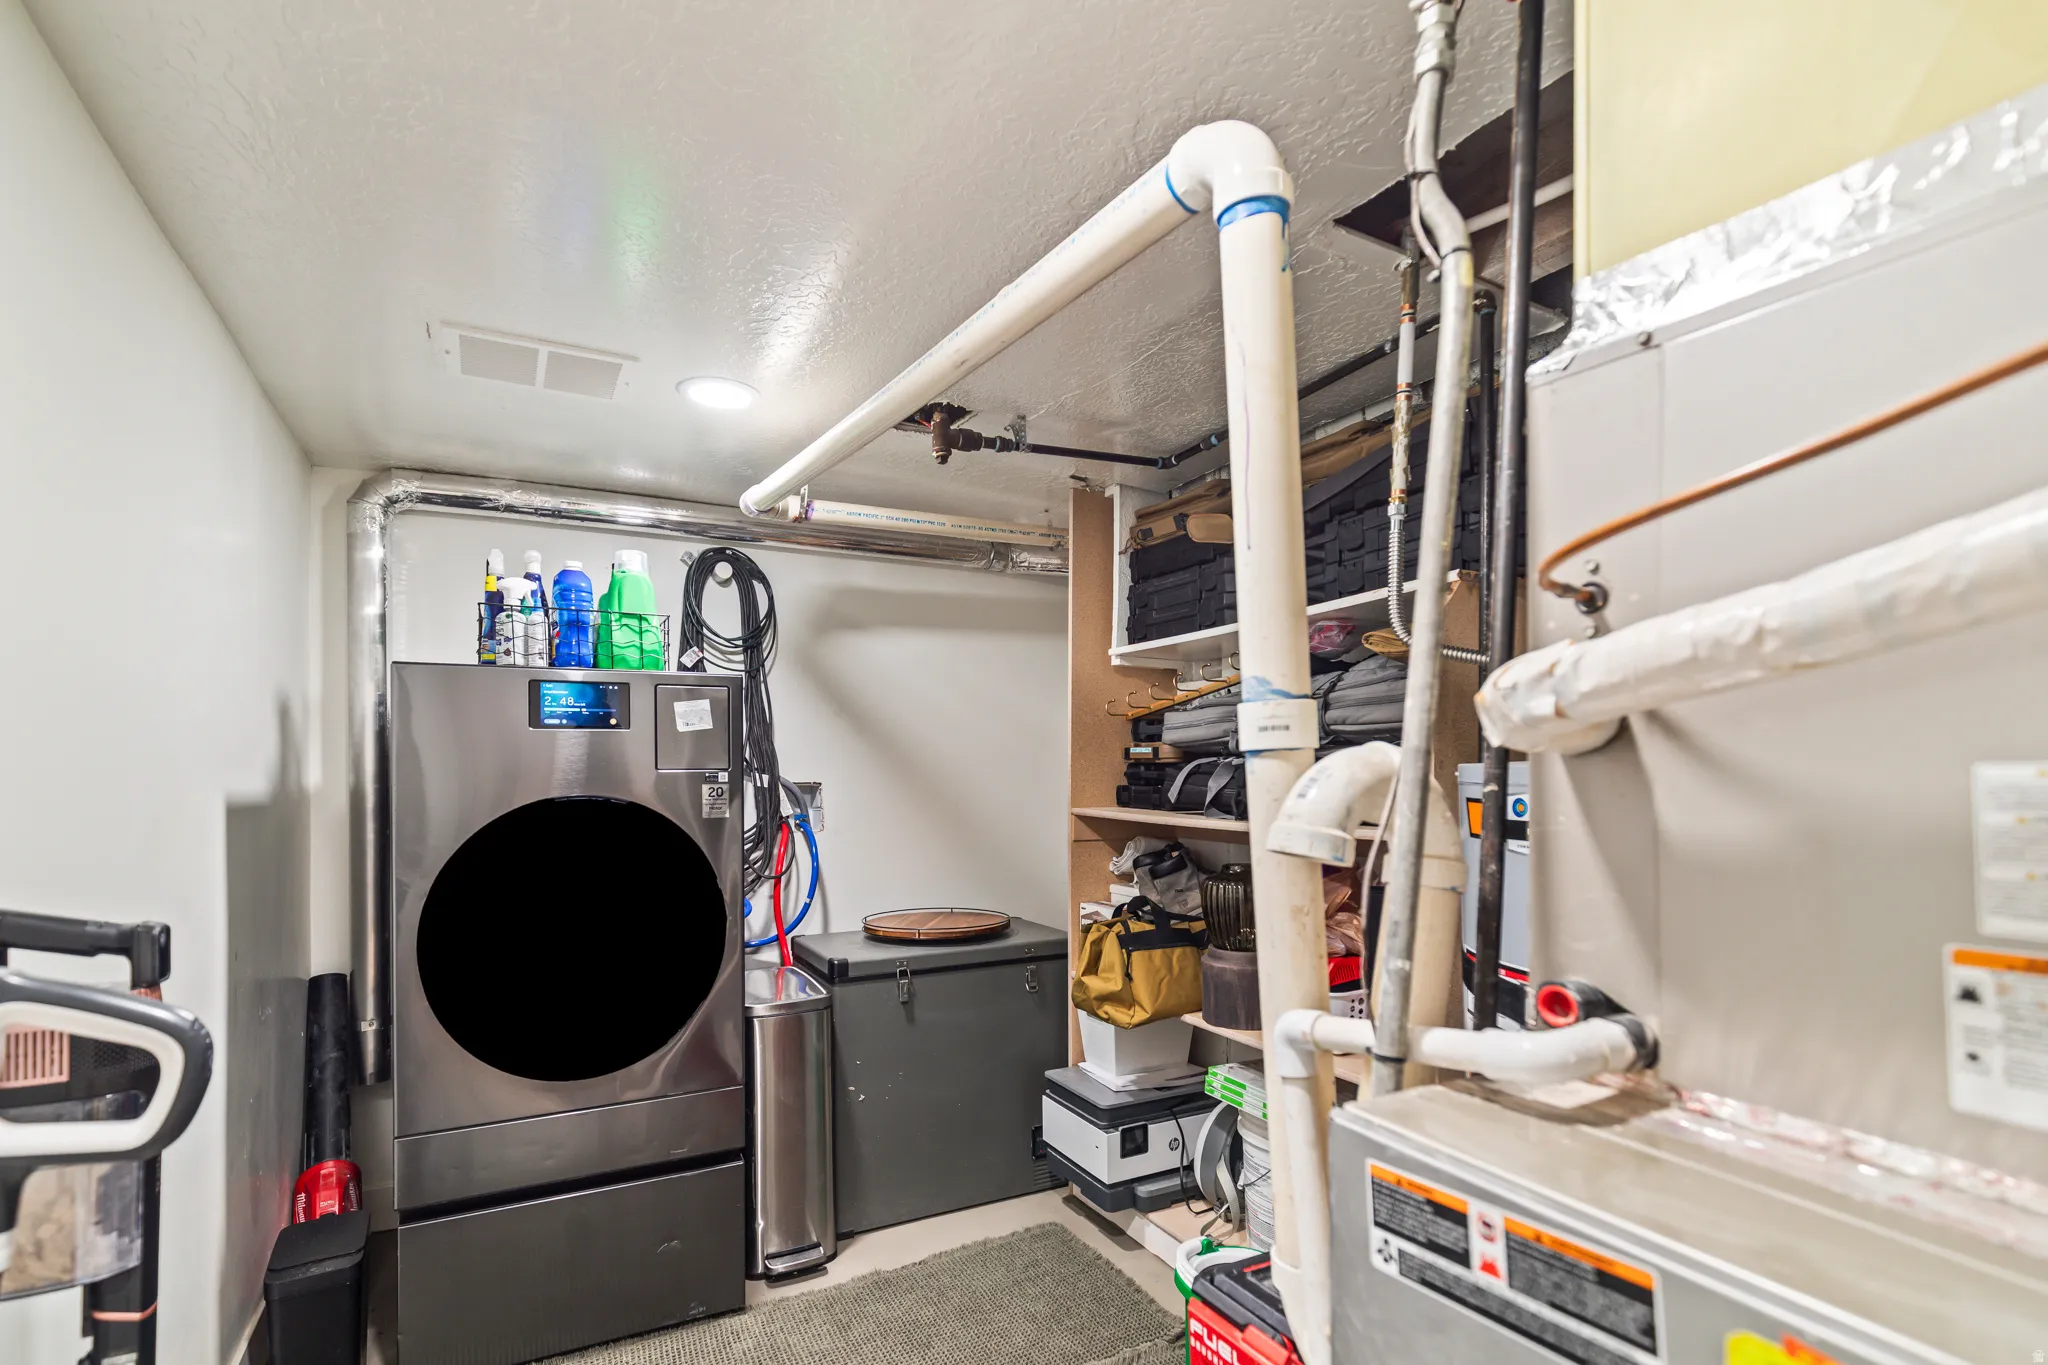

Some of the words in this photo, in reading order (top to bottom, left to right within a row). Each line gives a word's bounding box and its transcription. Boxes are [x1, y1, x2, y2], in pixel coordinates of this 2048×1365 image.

[544, 696, 552, 706] 2
[560, 696, 574, 706] 48
[708, 786, 724, 798] 20
[1189, 1317, 1240, 1365] FUEL
